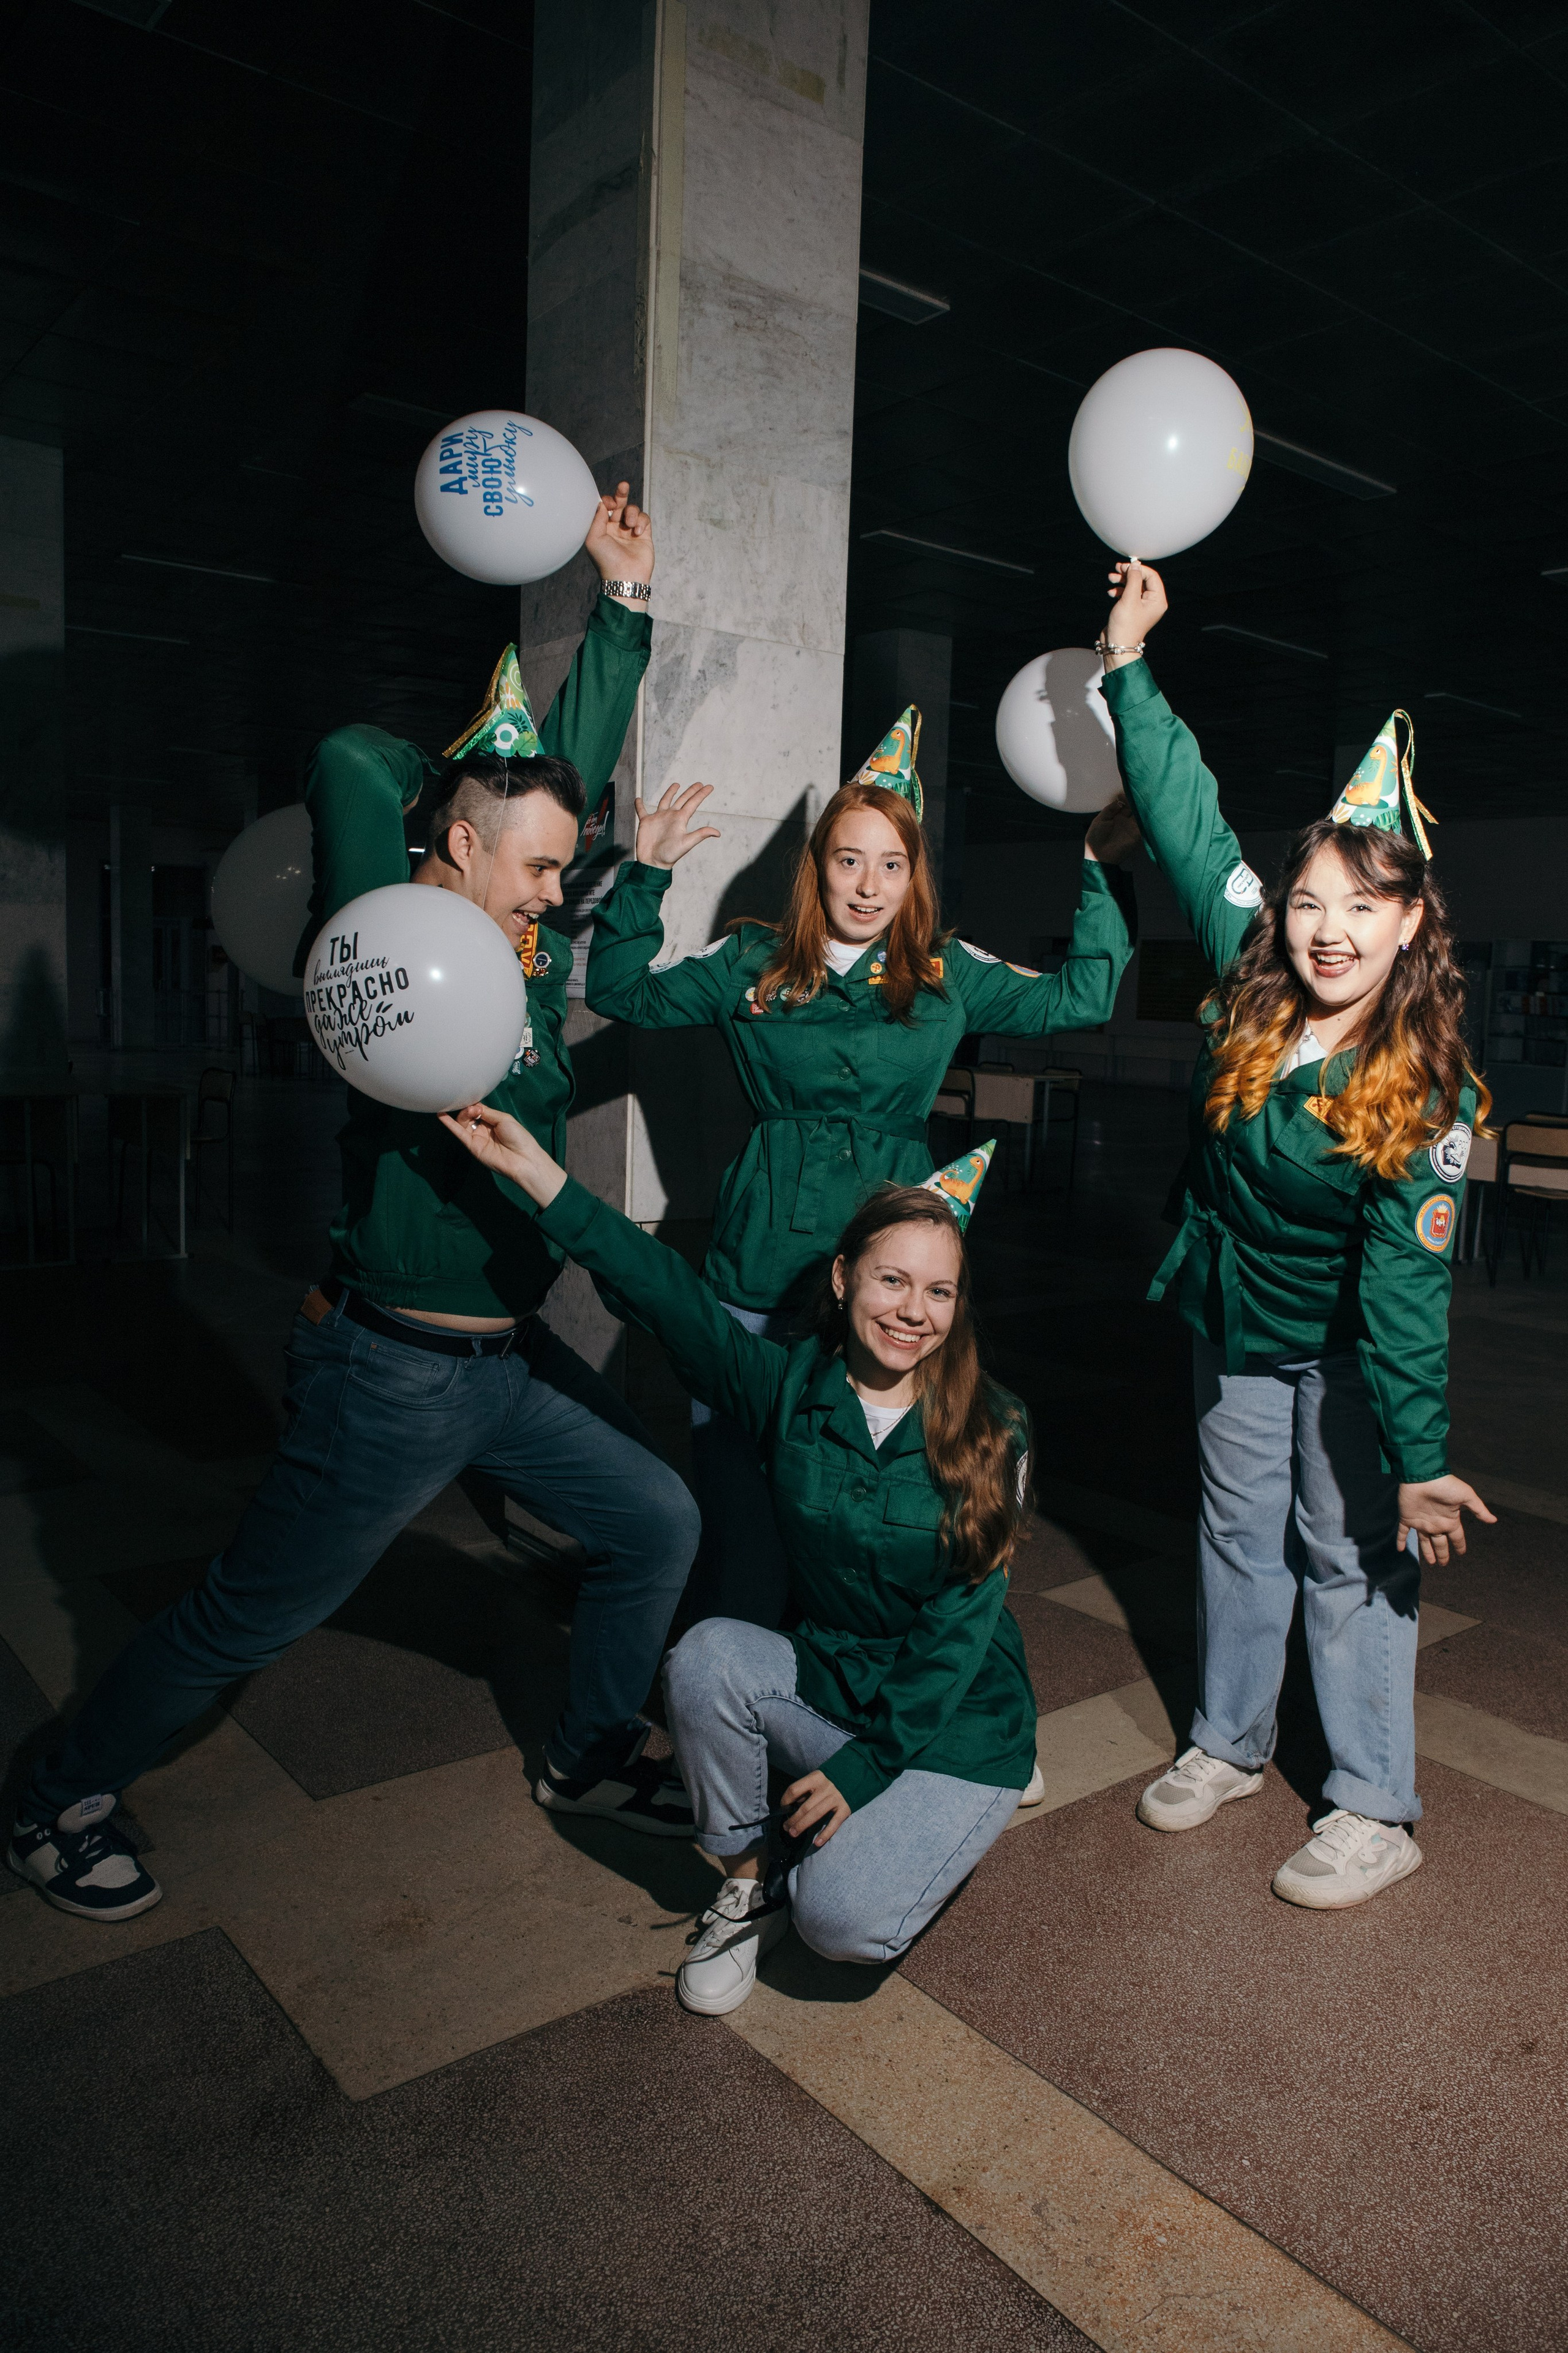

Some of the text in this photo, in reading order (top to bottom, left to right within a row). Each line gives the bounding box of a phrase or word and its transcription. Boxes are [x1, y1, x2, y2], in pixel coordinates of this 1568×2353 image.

[439, 432, 468, 495] ДАРИ
[463, 426, 494, 488] миру
[481, 456, 503, 518] СВОЮ
[483, 419, 534, 507] улыбку
[330, 932, 359, 966] ТЫ
[306, 967, 410, 1013] ПРЕКРАСНО
[315, 1000, 373, 1049] даже
[327, 1011, 415, 1071] утром
